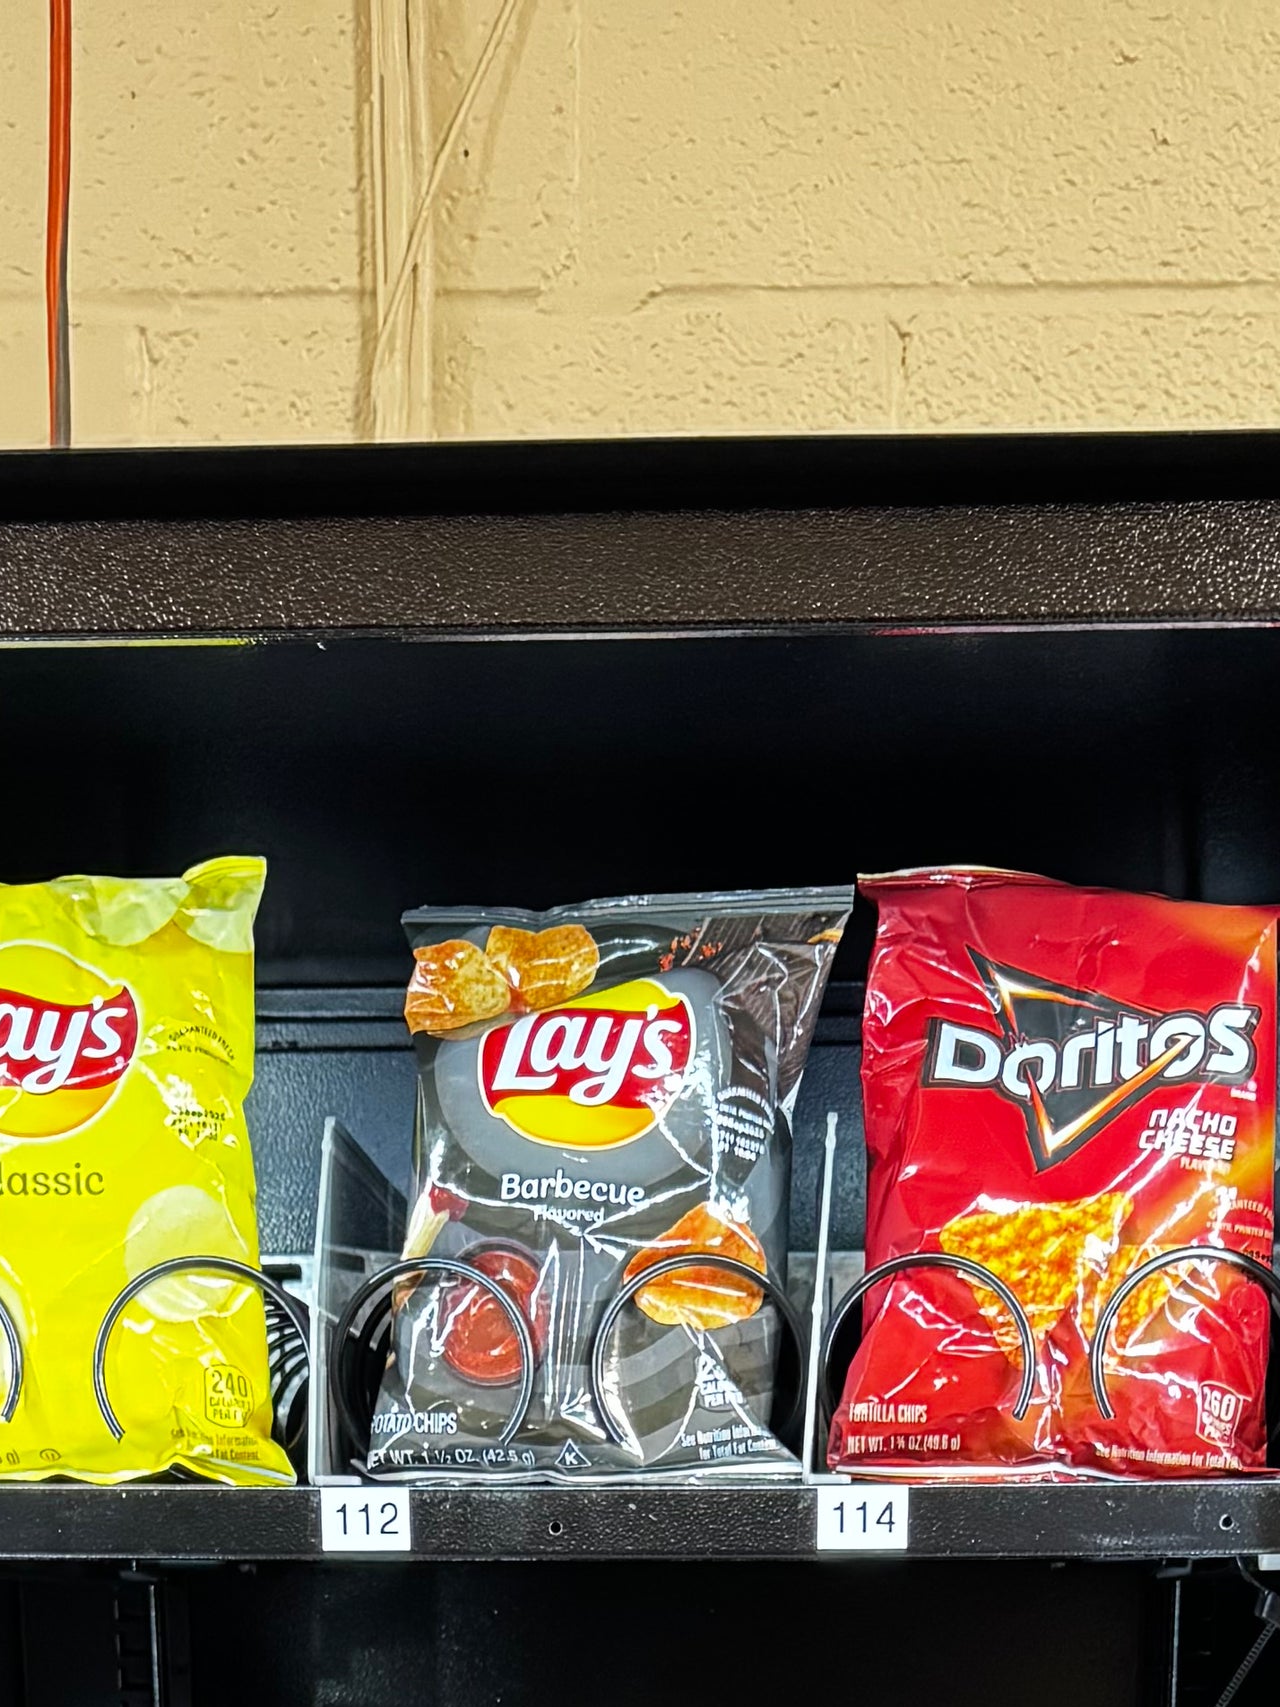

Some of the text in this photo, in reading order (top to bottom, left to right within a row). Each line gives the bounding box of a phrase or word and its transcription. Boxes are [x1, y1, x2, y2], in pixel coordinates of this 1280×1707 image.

[492, 1003, 684, 1106] Lay's
[932, 1005, 1254, 1097] Doritos
[1149, 1108, 1237, 1136] NACHO
[1139, 1129, 1236, 1160] CHEESE
[500, 1168, 645, 1207] Barbecue
[533, 1205, 605, 1223] Flavored
[211, 1370, 247, 1397] 240
[413, 1412, 457, 1434] CHIPS
[849, 1402, 928, 1423] TORTILLA CHIPS
[336, 1502, 399, 1535] 112
[833, 1501, 895, 1534] 114
